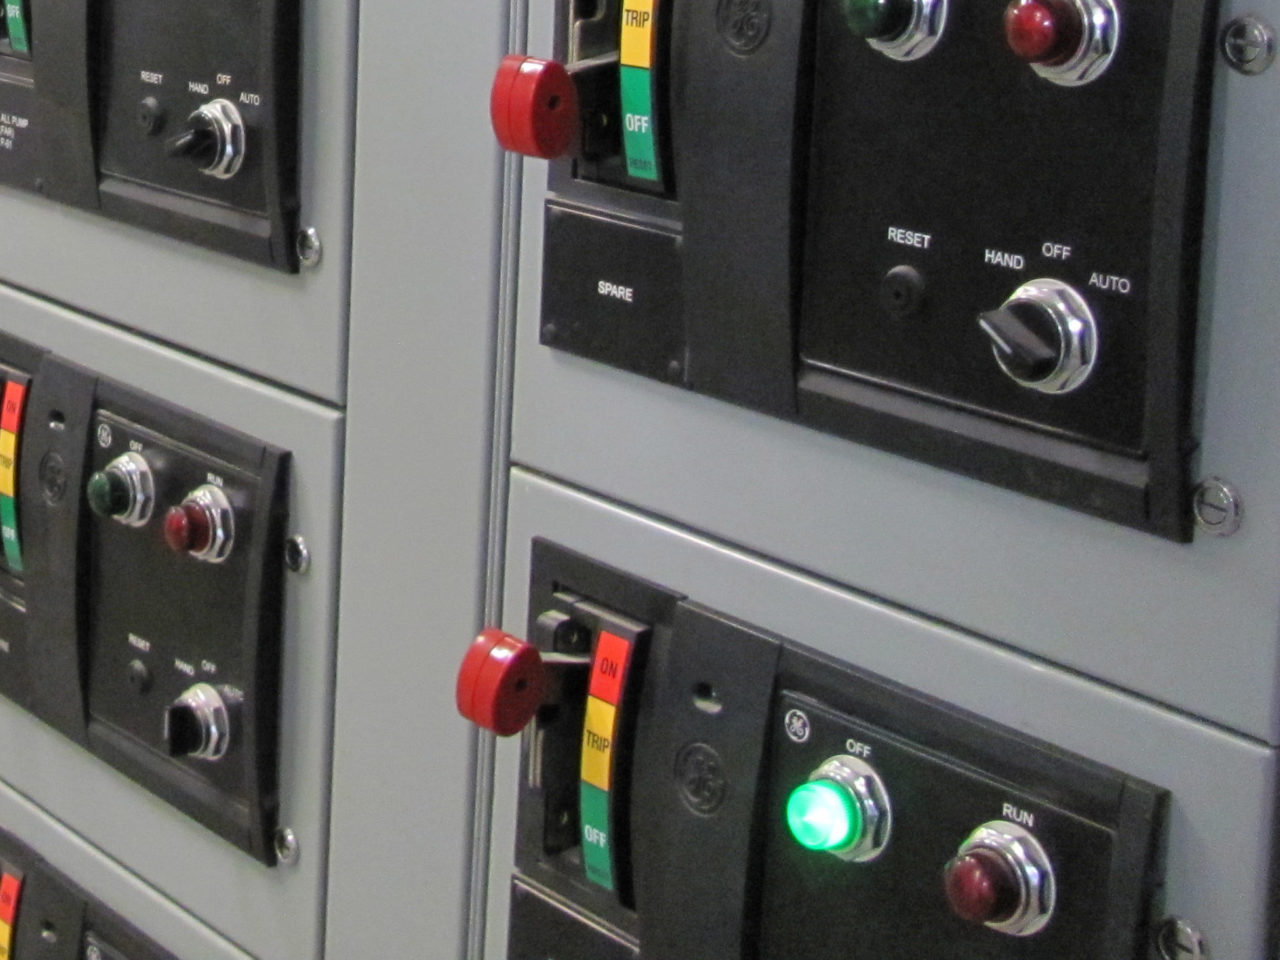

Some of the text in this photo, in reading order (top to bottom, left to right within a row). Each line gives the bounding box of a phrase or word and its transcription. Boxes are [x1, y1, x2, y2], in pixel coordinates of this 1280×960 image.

[625, 8, 650, 29] TRIP
[140, 70, 260, 105] RESET HAND OFF AUTO
[625, 113, 649, 133] OFF
[888, 226, 1131, 294] RESET HAND OFF AUTO
[598, 280, 633, 302] SPARE
[600, 657, 618, 679] ON
[585, 730, 611, 754] TRIP
[846, 738, 1035, 828] OFF RUN
[584, 824, 606, 848] OFF
